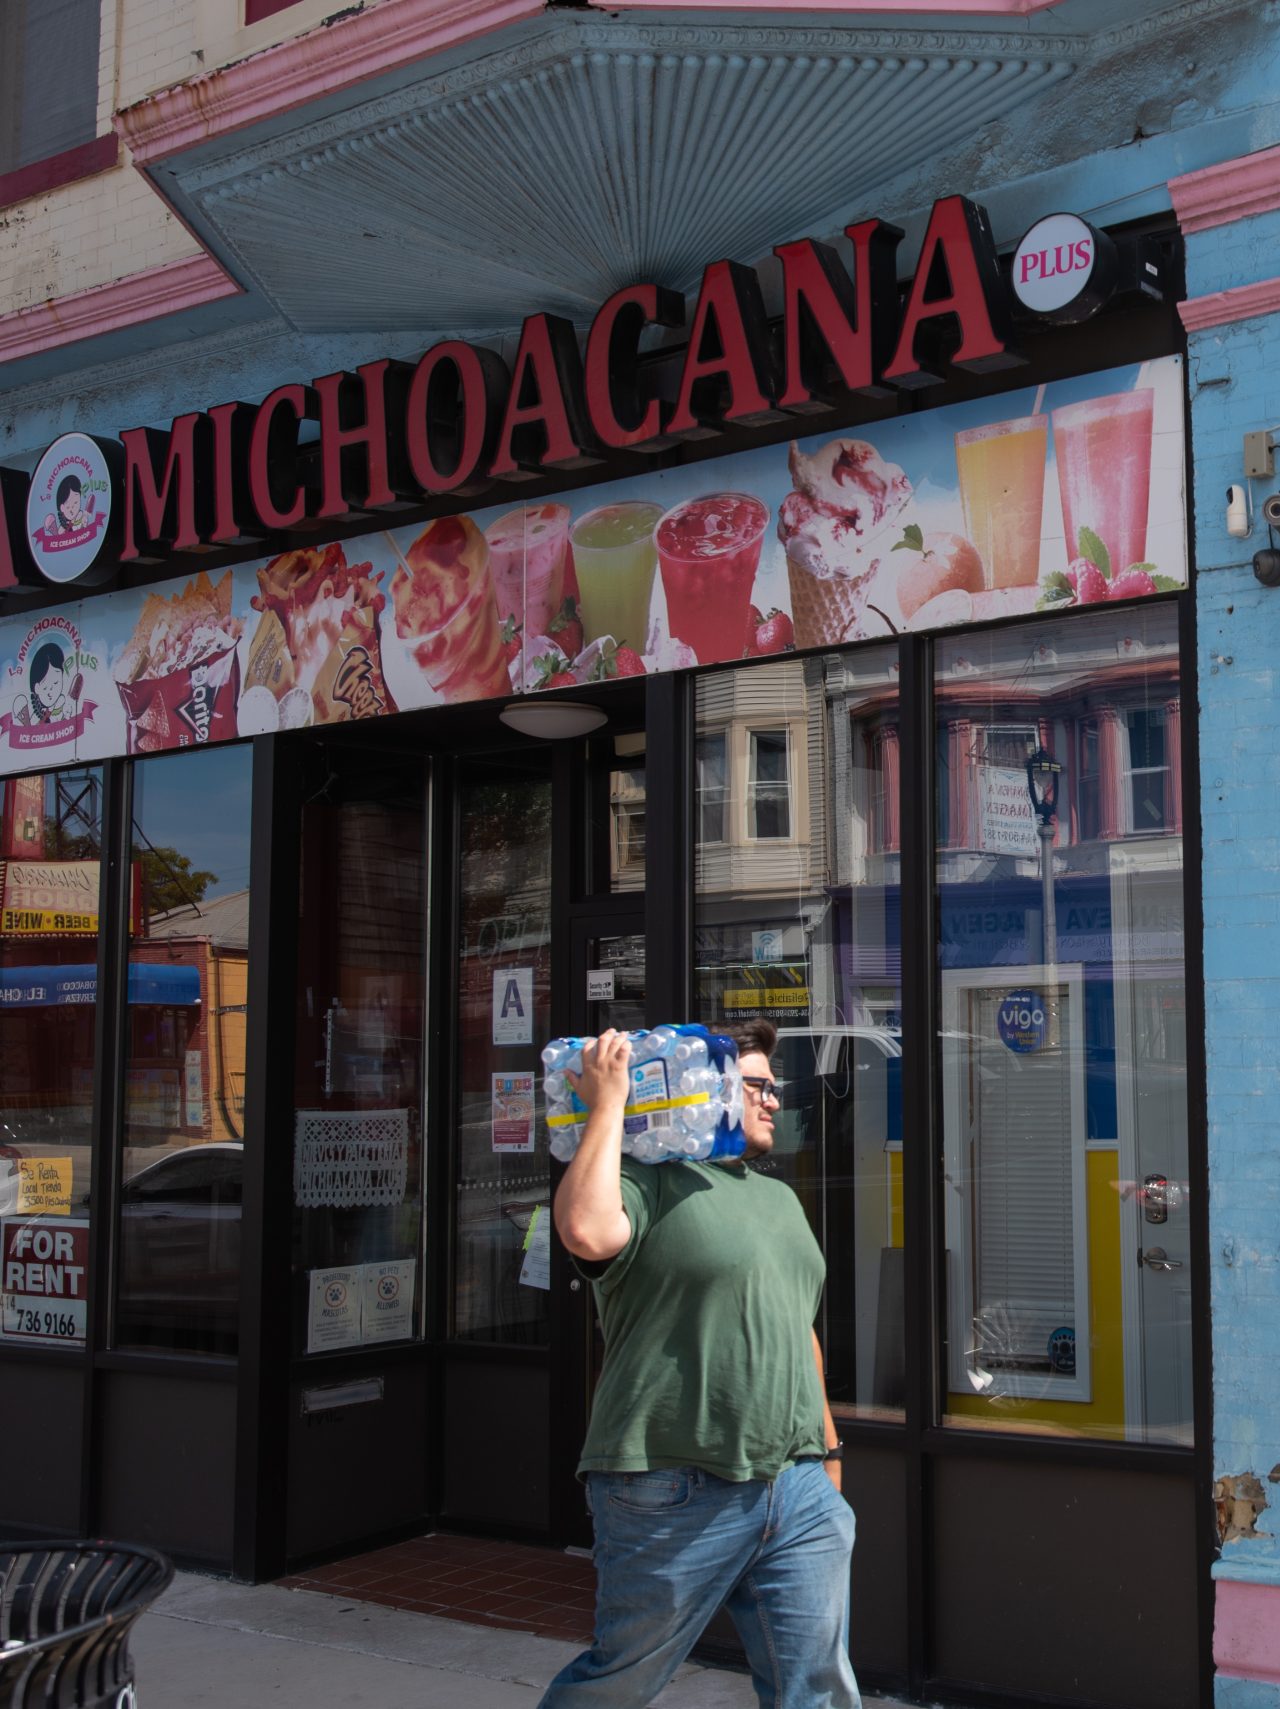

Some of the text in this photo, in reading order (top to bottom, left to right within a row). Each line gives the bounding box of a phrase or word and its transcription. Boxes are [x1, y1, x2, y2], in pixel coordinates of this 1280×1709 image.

[1019, 239, 1091, 284] PLUS
[120, 194, 1005, 562] MICHOACANA
[47, 456, 93, 490] MICHOACANA
[49, 531, 91, 548] ICE CREAM SHOP
[8, 665, 24, 677] La
[18, 616, 82, 662] MICHOACANA
[191, 665, 211, 743] Dorito
[19, 725, 75, 743] ICE CREAM SHOP
[501, 979, 524, 1017] A
[1002, 1005, 1044, 1029] vigo
[21, 1162, 59, 1180] Se Renta
[17, 1230, 74, 1261] FOR
[6, 1261, 84, 1295] RENT
[16, 1310, 75, 1336] 736 9166
